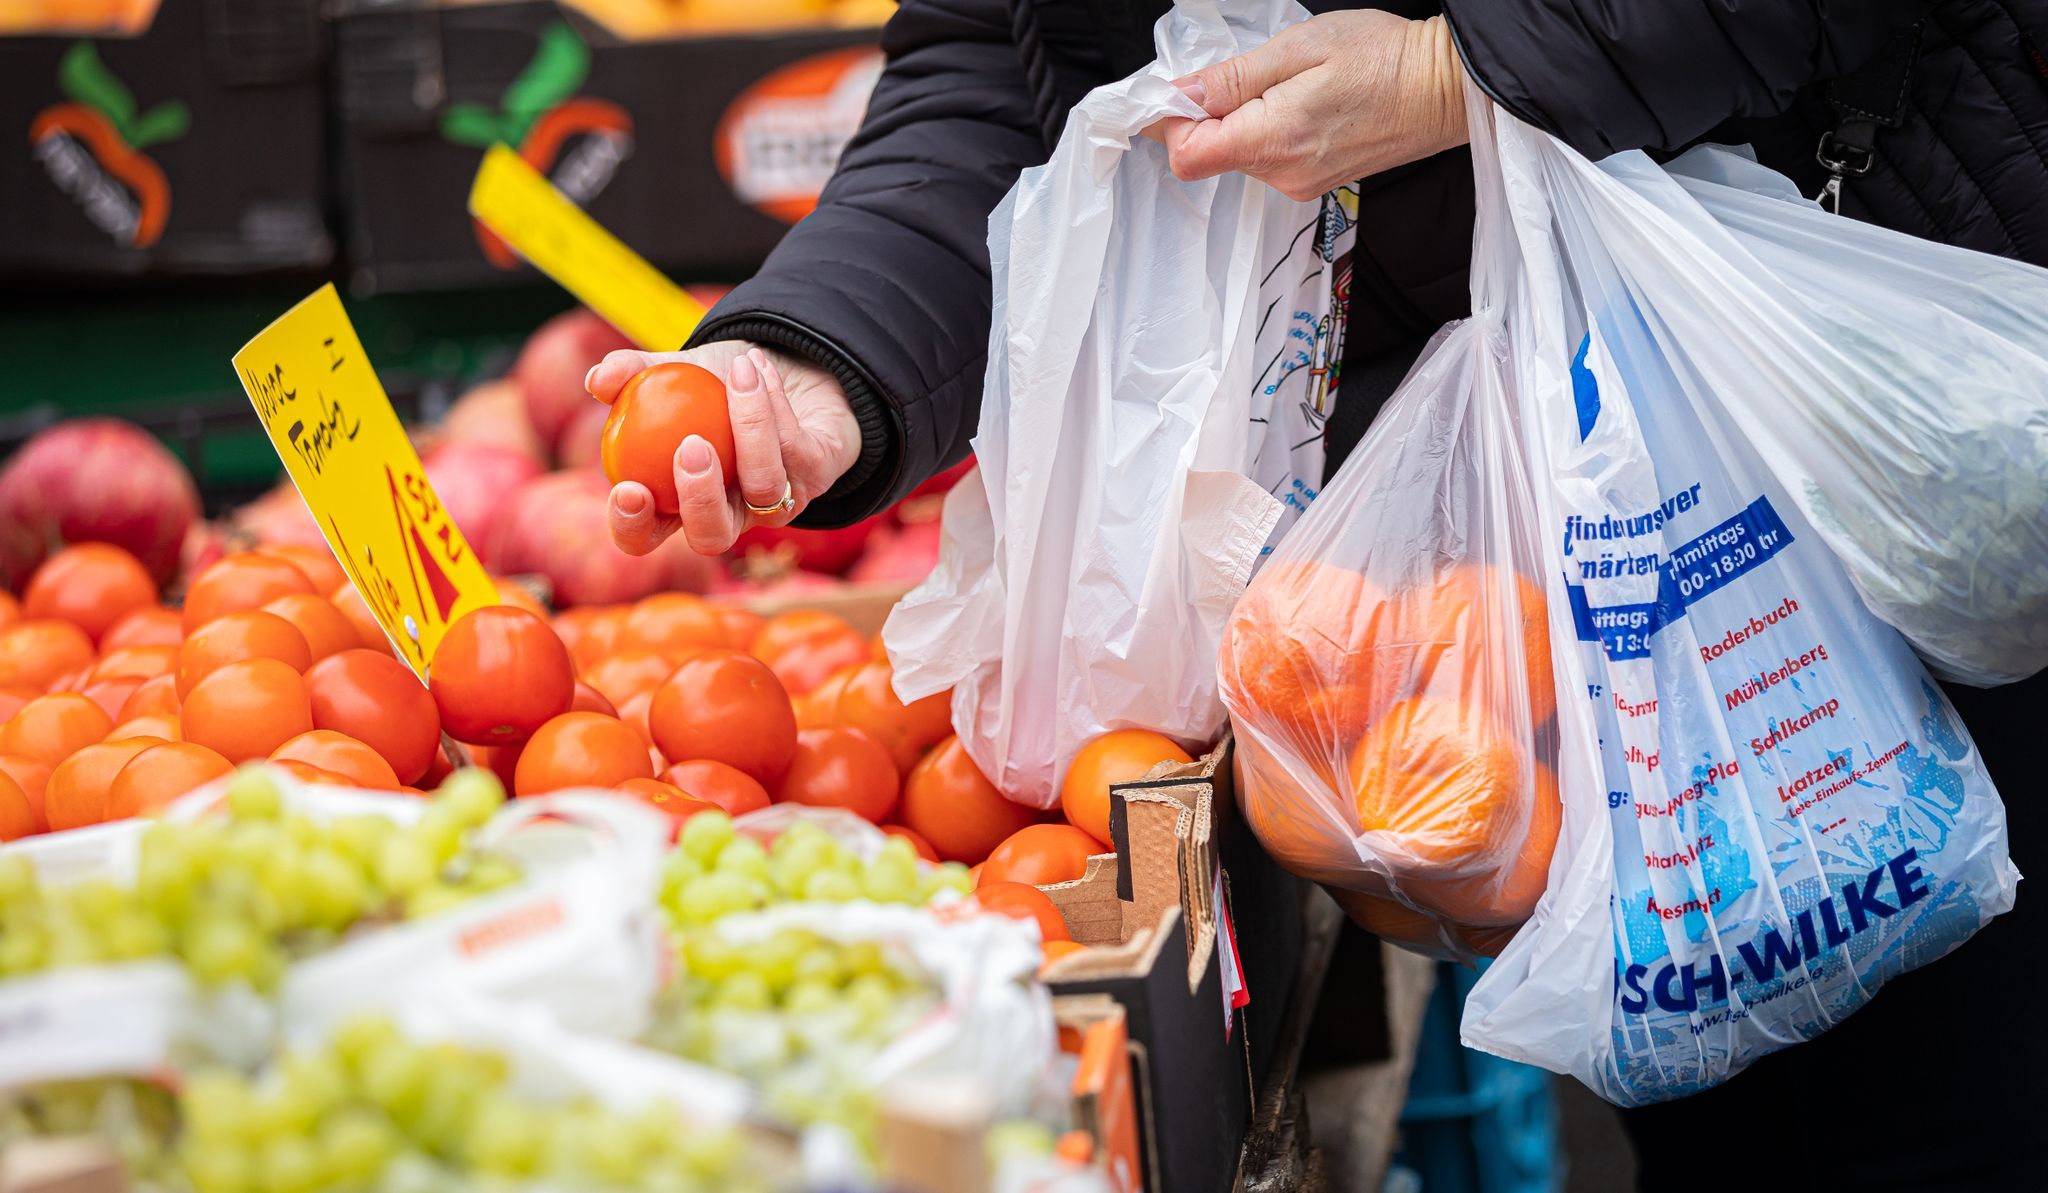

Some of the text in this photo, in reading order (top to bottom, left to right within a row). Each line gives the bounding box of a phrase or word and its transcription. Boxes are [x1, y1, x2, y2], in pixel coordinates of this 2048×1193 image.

[1724, 643, 1829, 712] Mühlenberg
[1750, 698, 1840, 757] Sahlkamp
[1614, 847, 1930, 1015] SCH-WILKE
